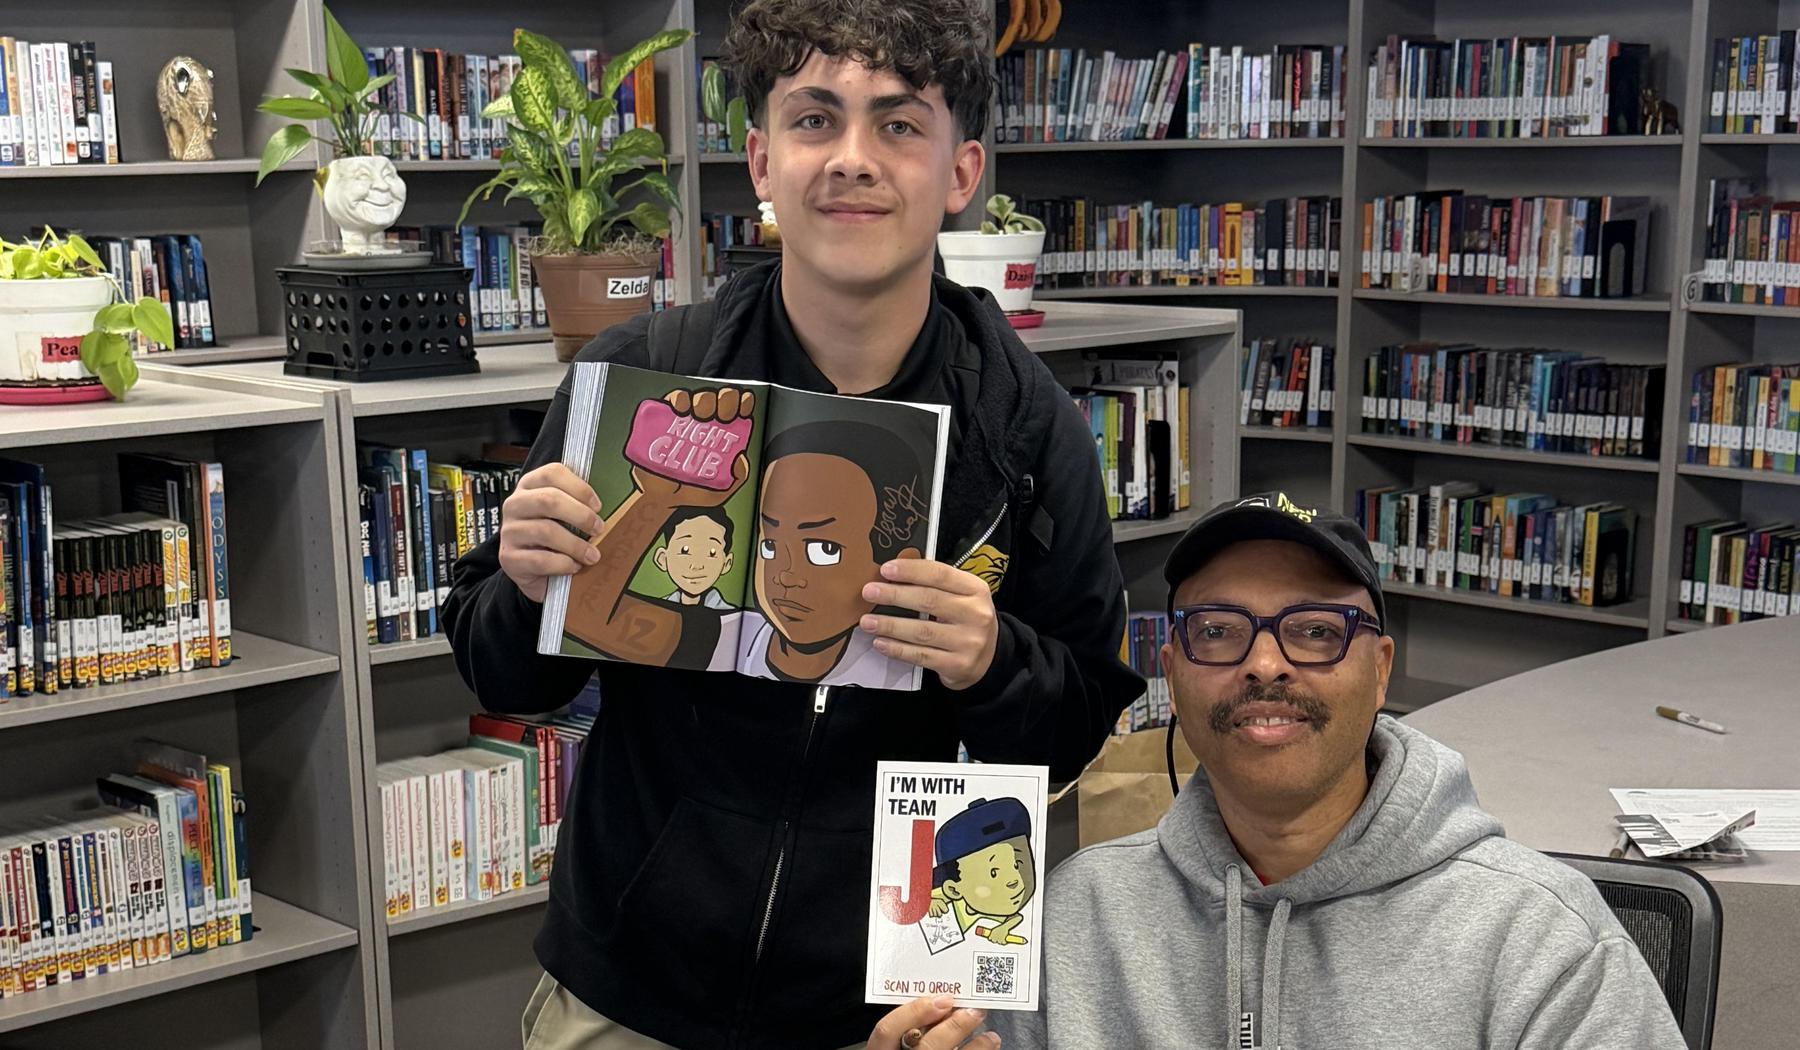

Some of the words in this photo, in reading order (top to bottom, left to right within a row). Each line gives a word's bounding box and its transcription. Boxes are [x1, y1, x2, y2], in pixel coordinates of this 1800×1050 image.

[610, 280, 649, 296] Zelda
[47, 341, 80, 358] Pea
[667, 416, 741, 453] RIGHT
[648, 435, 723, 479] CLUB
[890, 776, 917, 794] I'M
[921, 777, 965, 795] WITH
[888, 799, 936, 816] TEAM
[879, 819, 936, 926] J
[883, 979, 910, 993] SCAN
[913, 981, 926, 993] TO
[928, 981, 962, 994] ORDER
